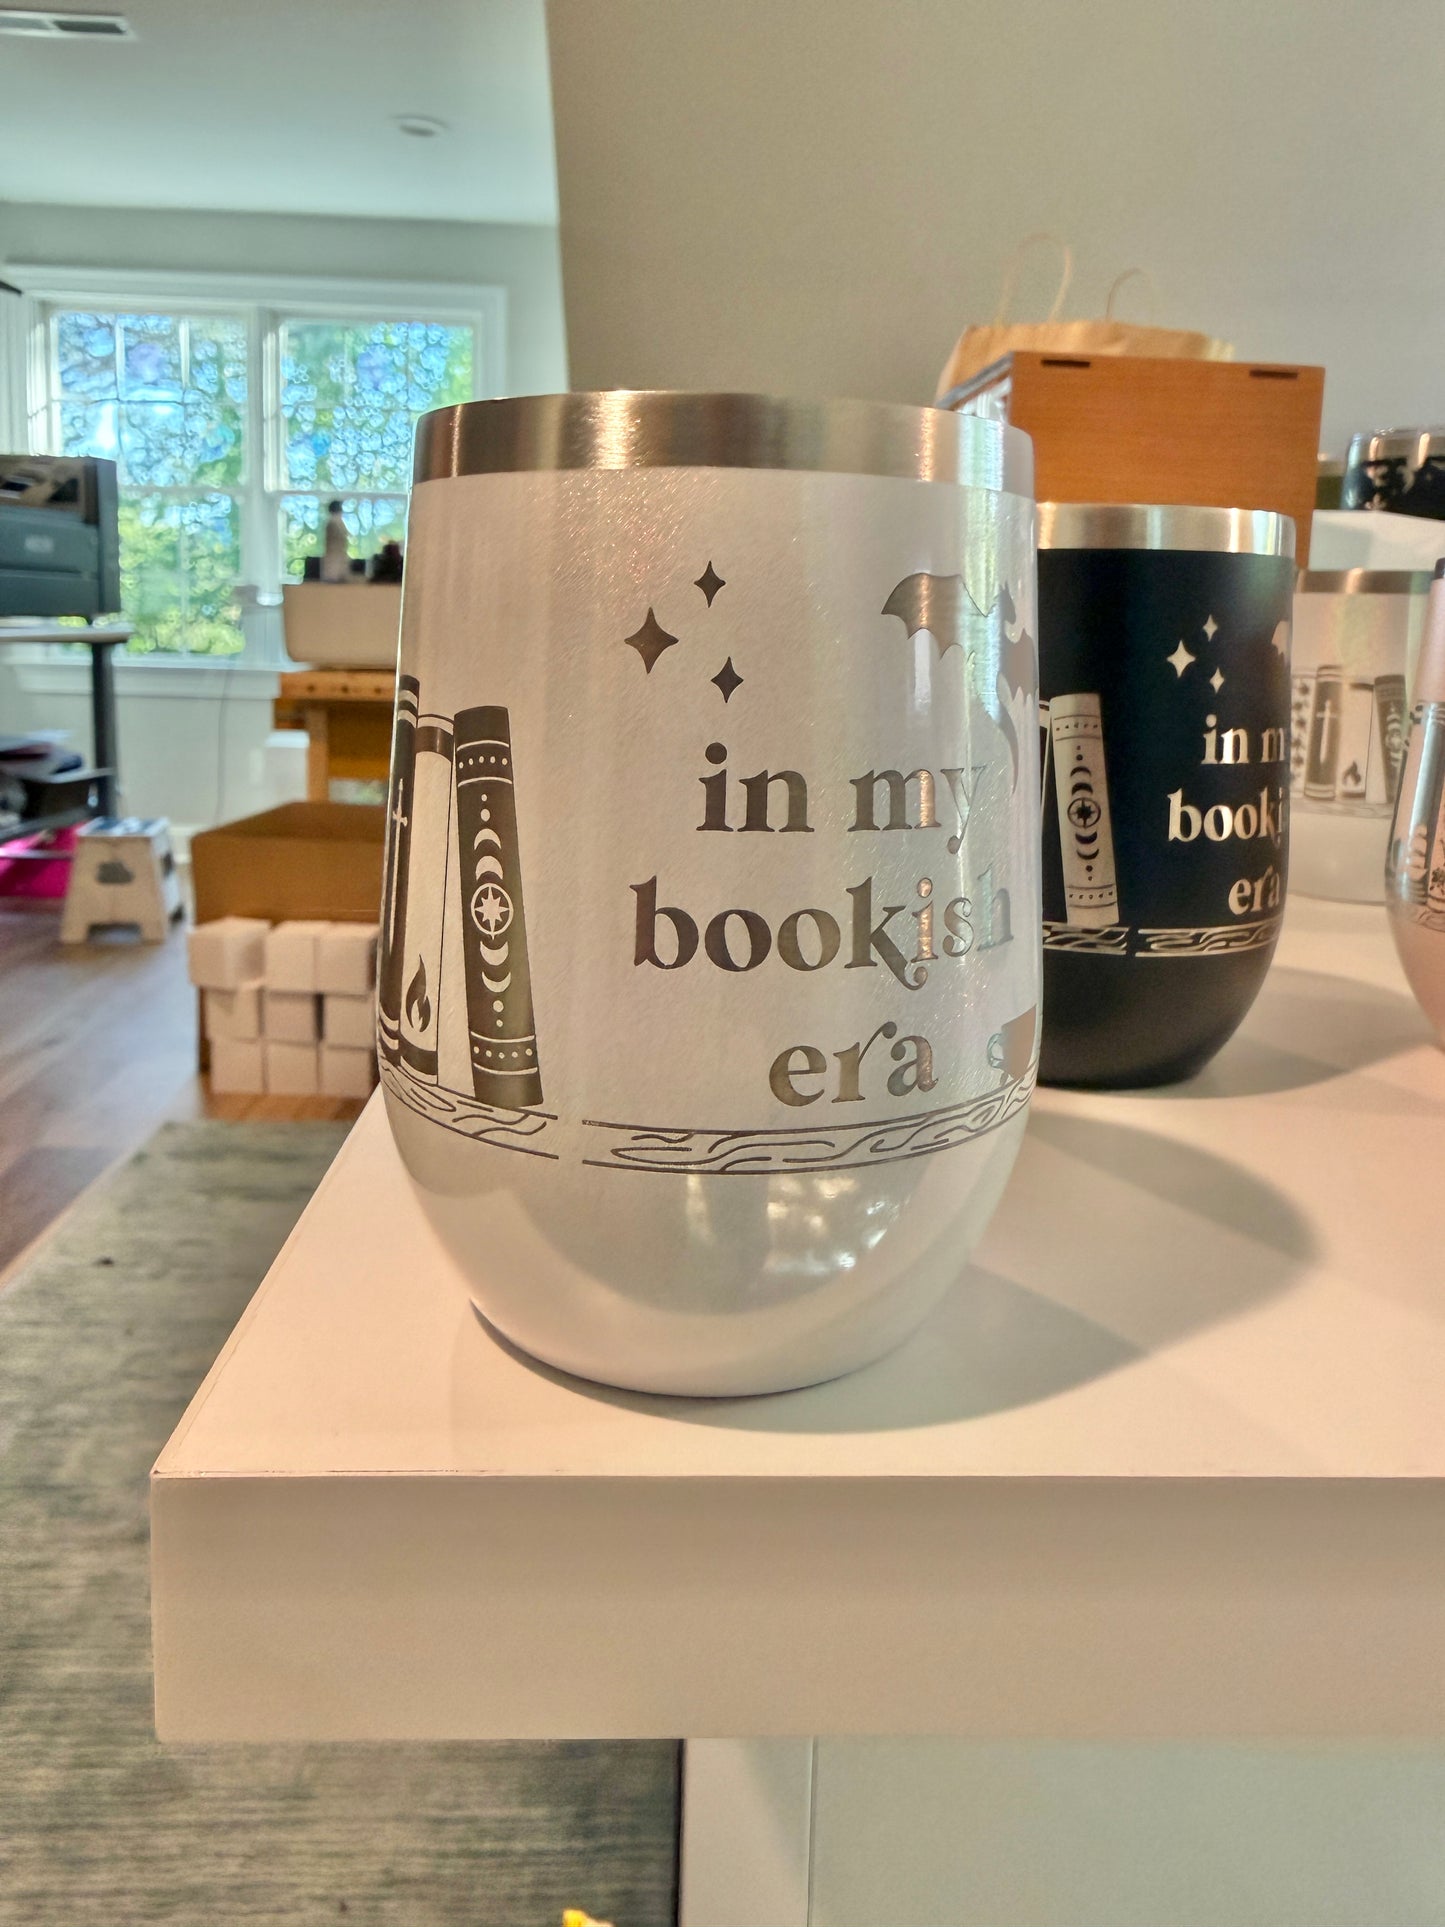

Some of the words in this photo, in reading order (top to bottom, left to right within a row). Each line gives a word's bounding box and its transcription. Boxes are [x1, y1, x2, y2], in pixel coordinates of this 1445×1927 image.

[1201, 713, 1249, 764] in
[696, 742, 815, 833] in
[848, 763, 987, 854] my
[629, 865, 1014, 990] bookish
[1228, 865, 1280, 915] era
[769, 1020, 938, 1107] era
